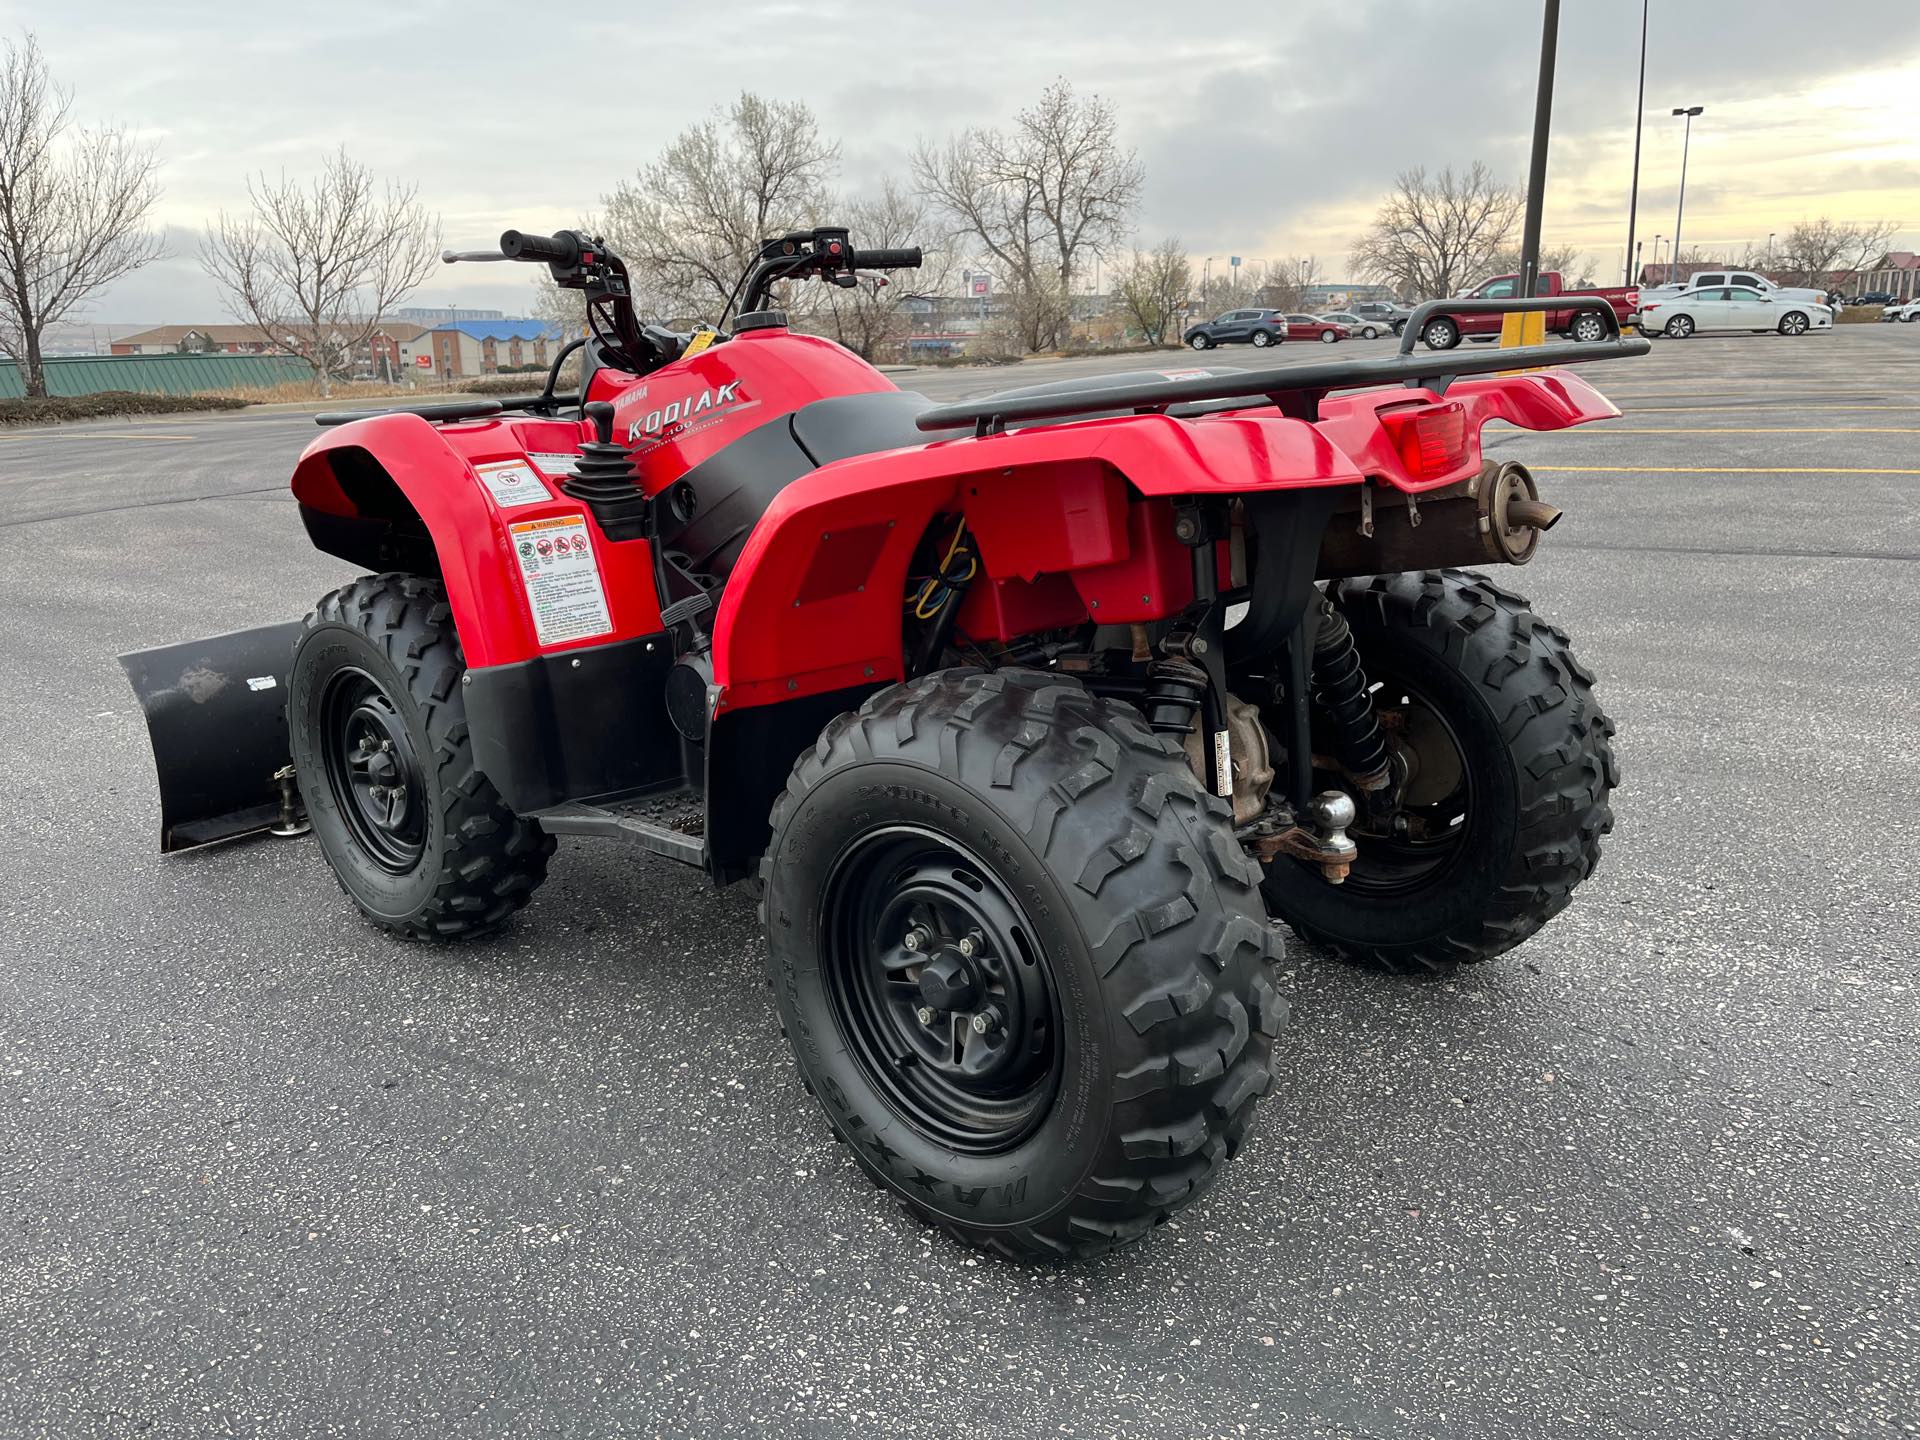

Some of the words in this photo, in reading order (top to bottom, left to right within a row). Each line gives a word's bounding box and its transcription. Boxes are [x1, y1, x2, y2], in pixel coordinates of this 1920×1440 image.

[615, 386, 648, 411] YAMAHA
[628, 380, 742, 443] KODIAK
[537, 519, 565, 529] WARNING
[821, 1075, 1028, 1208] MAXXIS
